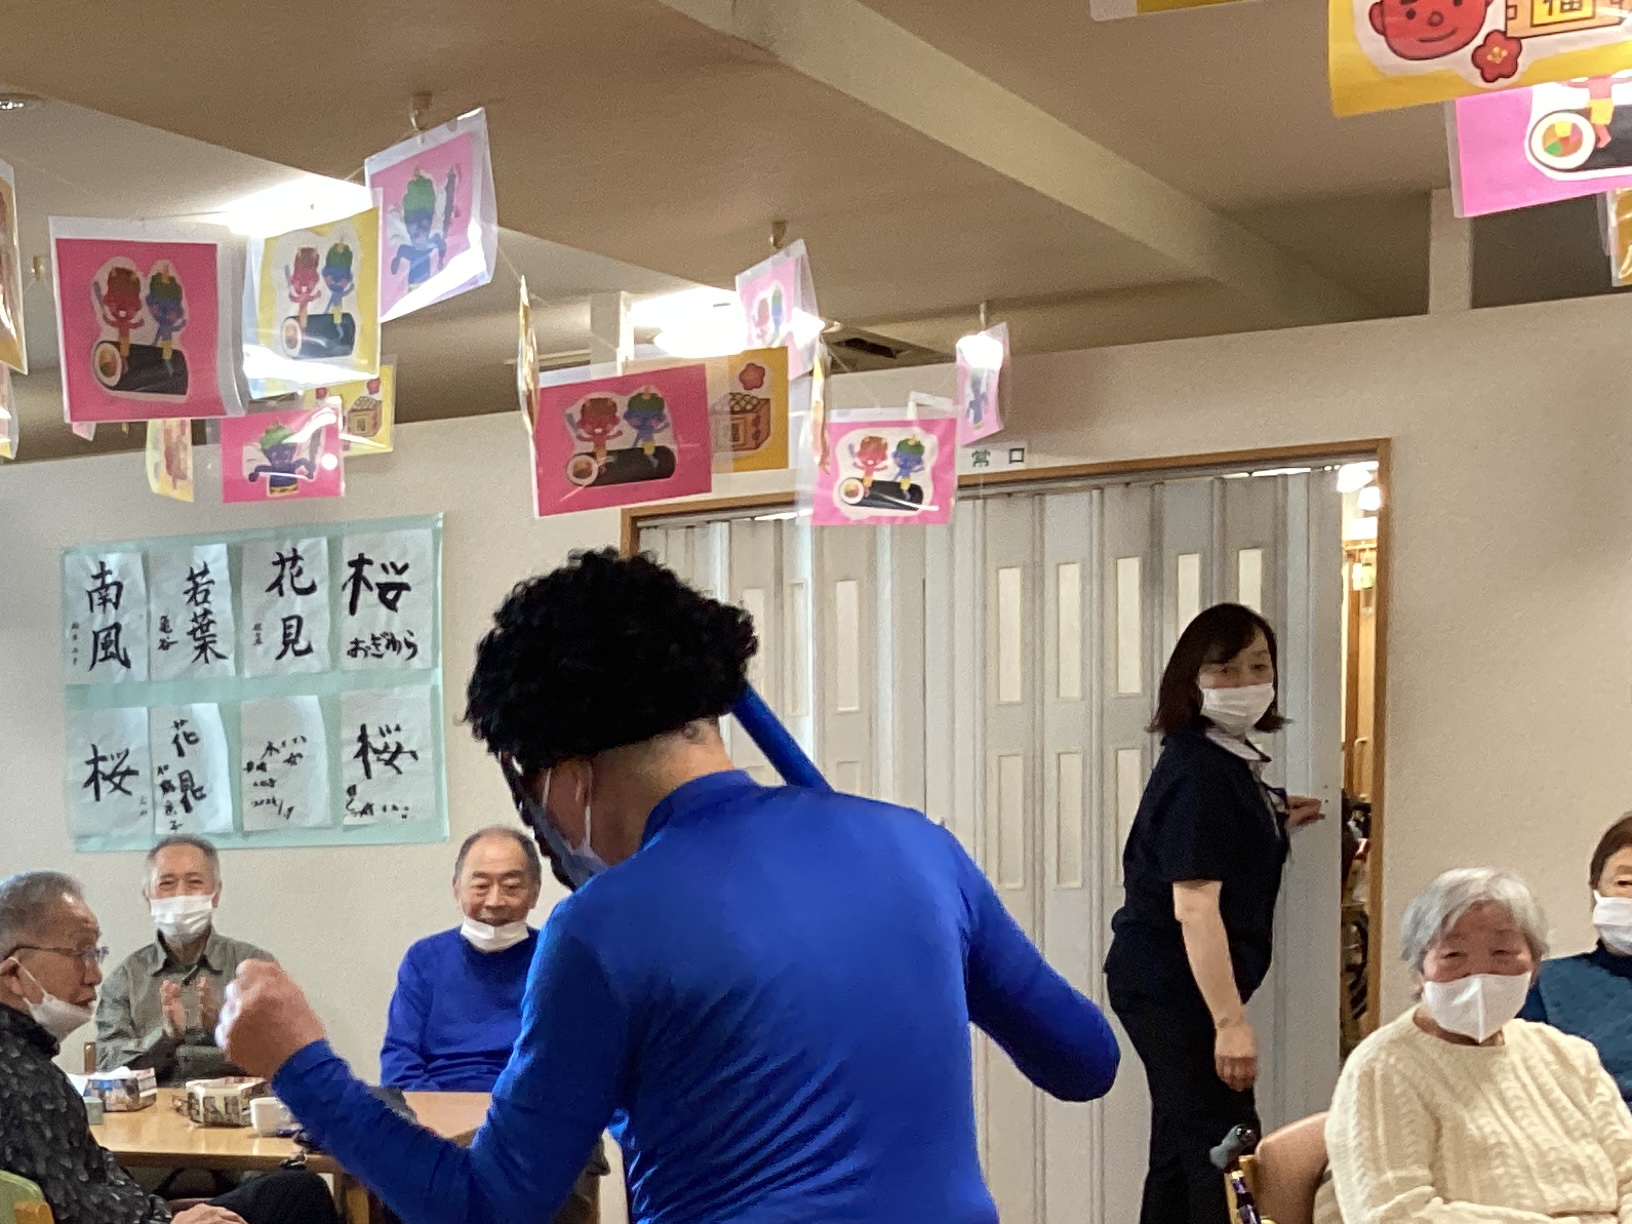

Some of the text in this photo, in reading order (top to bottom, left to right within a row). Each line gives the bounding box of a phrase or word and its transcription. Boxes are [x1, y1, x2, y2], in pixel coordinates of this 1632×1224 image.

[86, 560, 131, 672] 南風
[183, 561, 228, 664] 若葉
[265, 547, 317, 660] 花見
[341, 552, 412, 617] 桜
[82, 743, 140, 802] 桜
[353, 723, 419, 780] 桜
